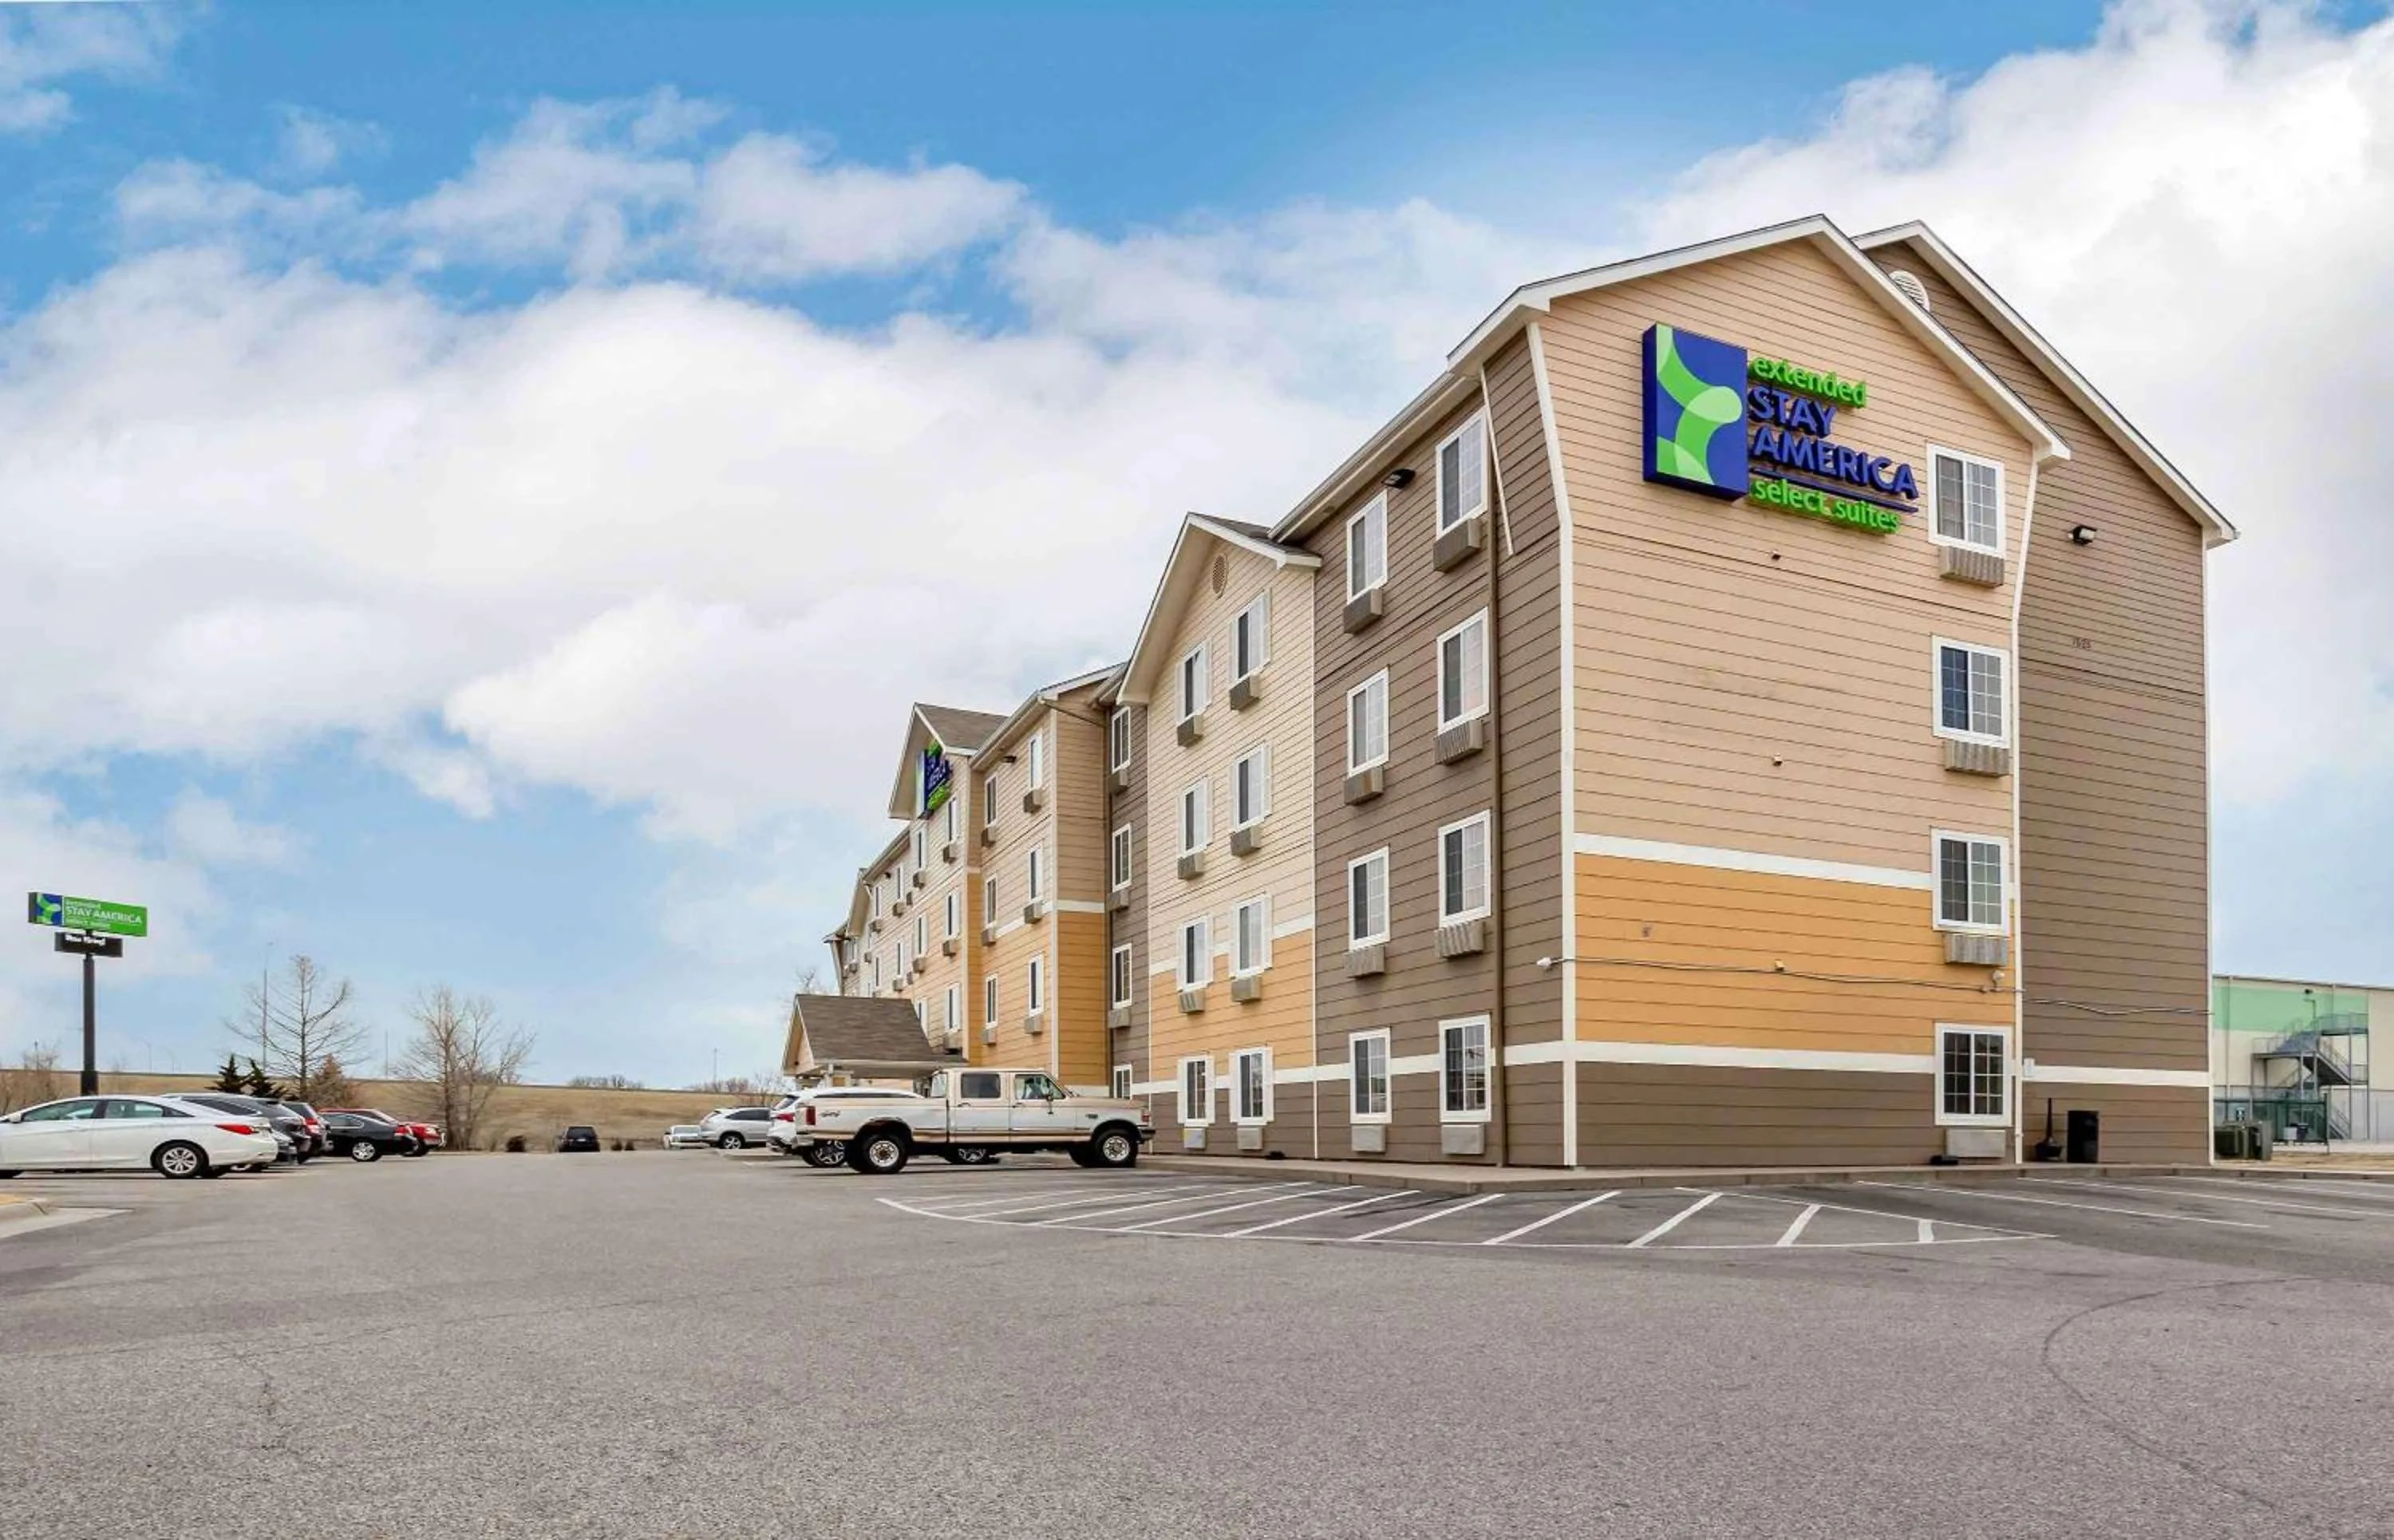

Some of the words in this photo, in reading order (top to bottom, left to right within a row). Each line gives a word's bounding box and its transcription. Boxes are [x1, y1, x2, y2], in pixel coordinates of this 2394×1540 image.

[1752, 357, 1866, 407] extended
[1750, 386, 1835, 437] STAY
[1753, 426, 1918, 500] AMERICA
[1752, 479, 1833, 516] select
[1835, 503, 1901, 533] suites
[65, 906, 92, 916] STAY
[93, 910, 141, 923] AMERICA
